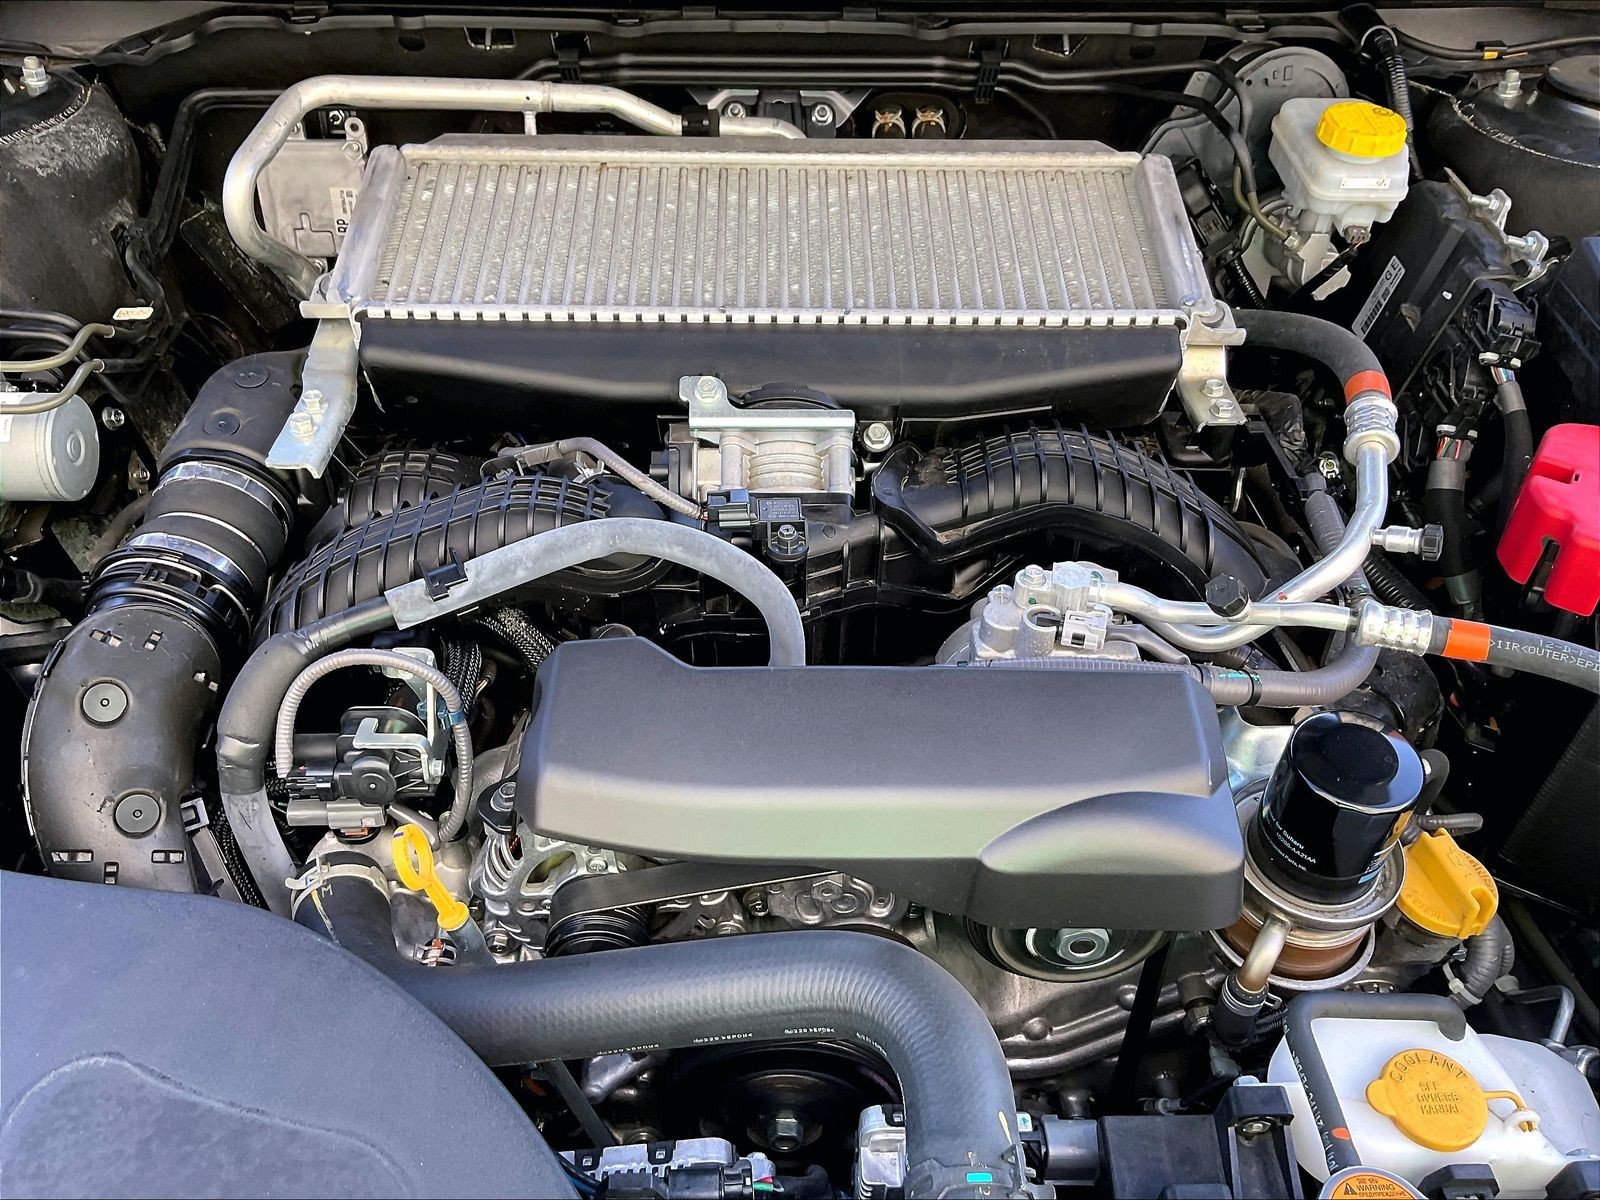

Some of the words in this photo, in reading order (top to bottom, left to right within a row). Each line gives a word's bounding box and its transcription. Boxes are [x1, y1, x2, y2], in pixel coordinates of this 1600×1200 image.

[1282, 829, 1305, 850] Subaru
[1390, 1053, 1468, 1083] COOLANT
[1418, 1080, 1440, 1092] SEE
[1420, 1103, 1460, 1115] MANUAL
[1356, 1183, 1396, 1191] WARNING
